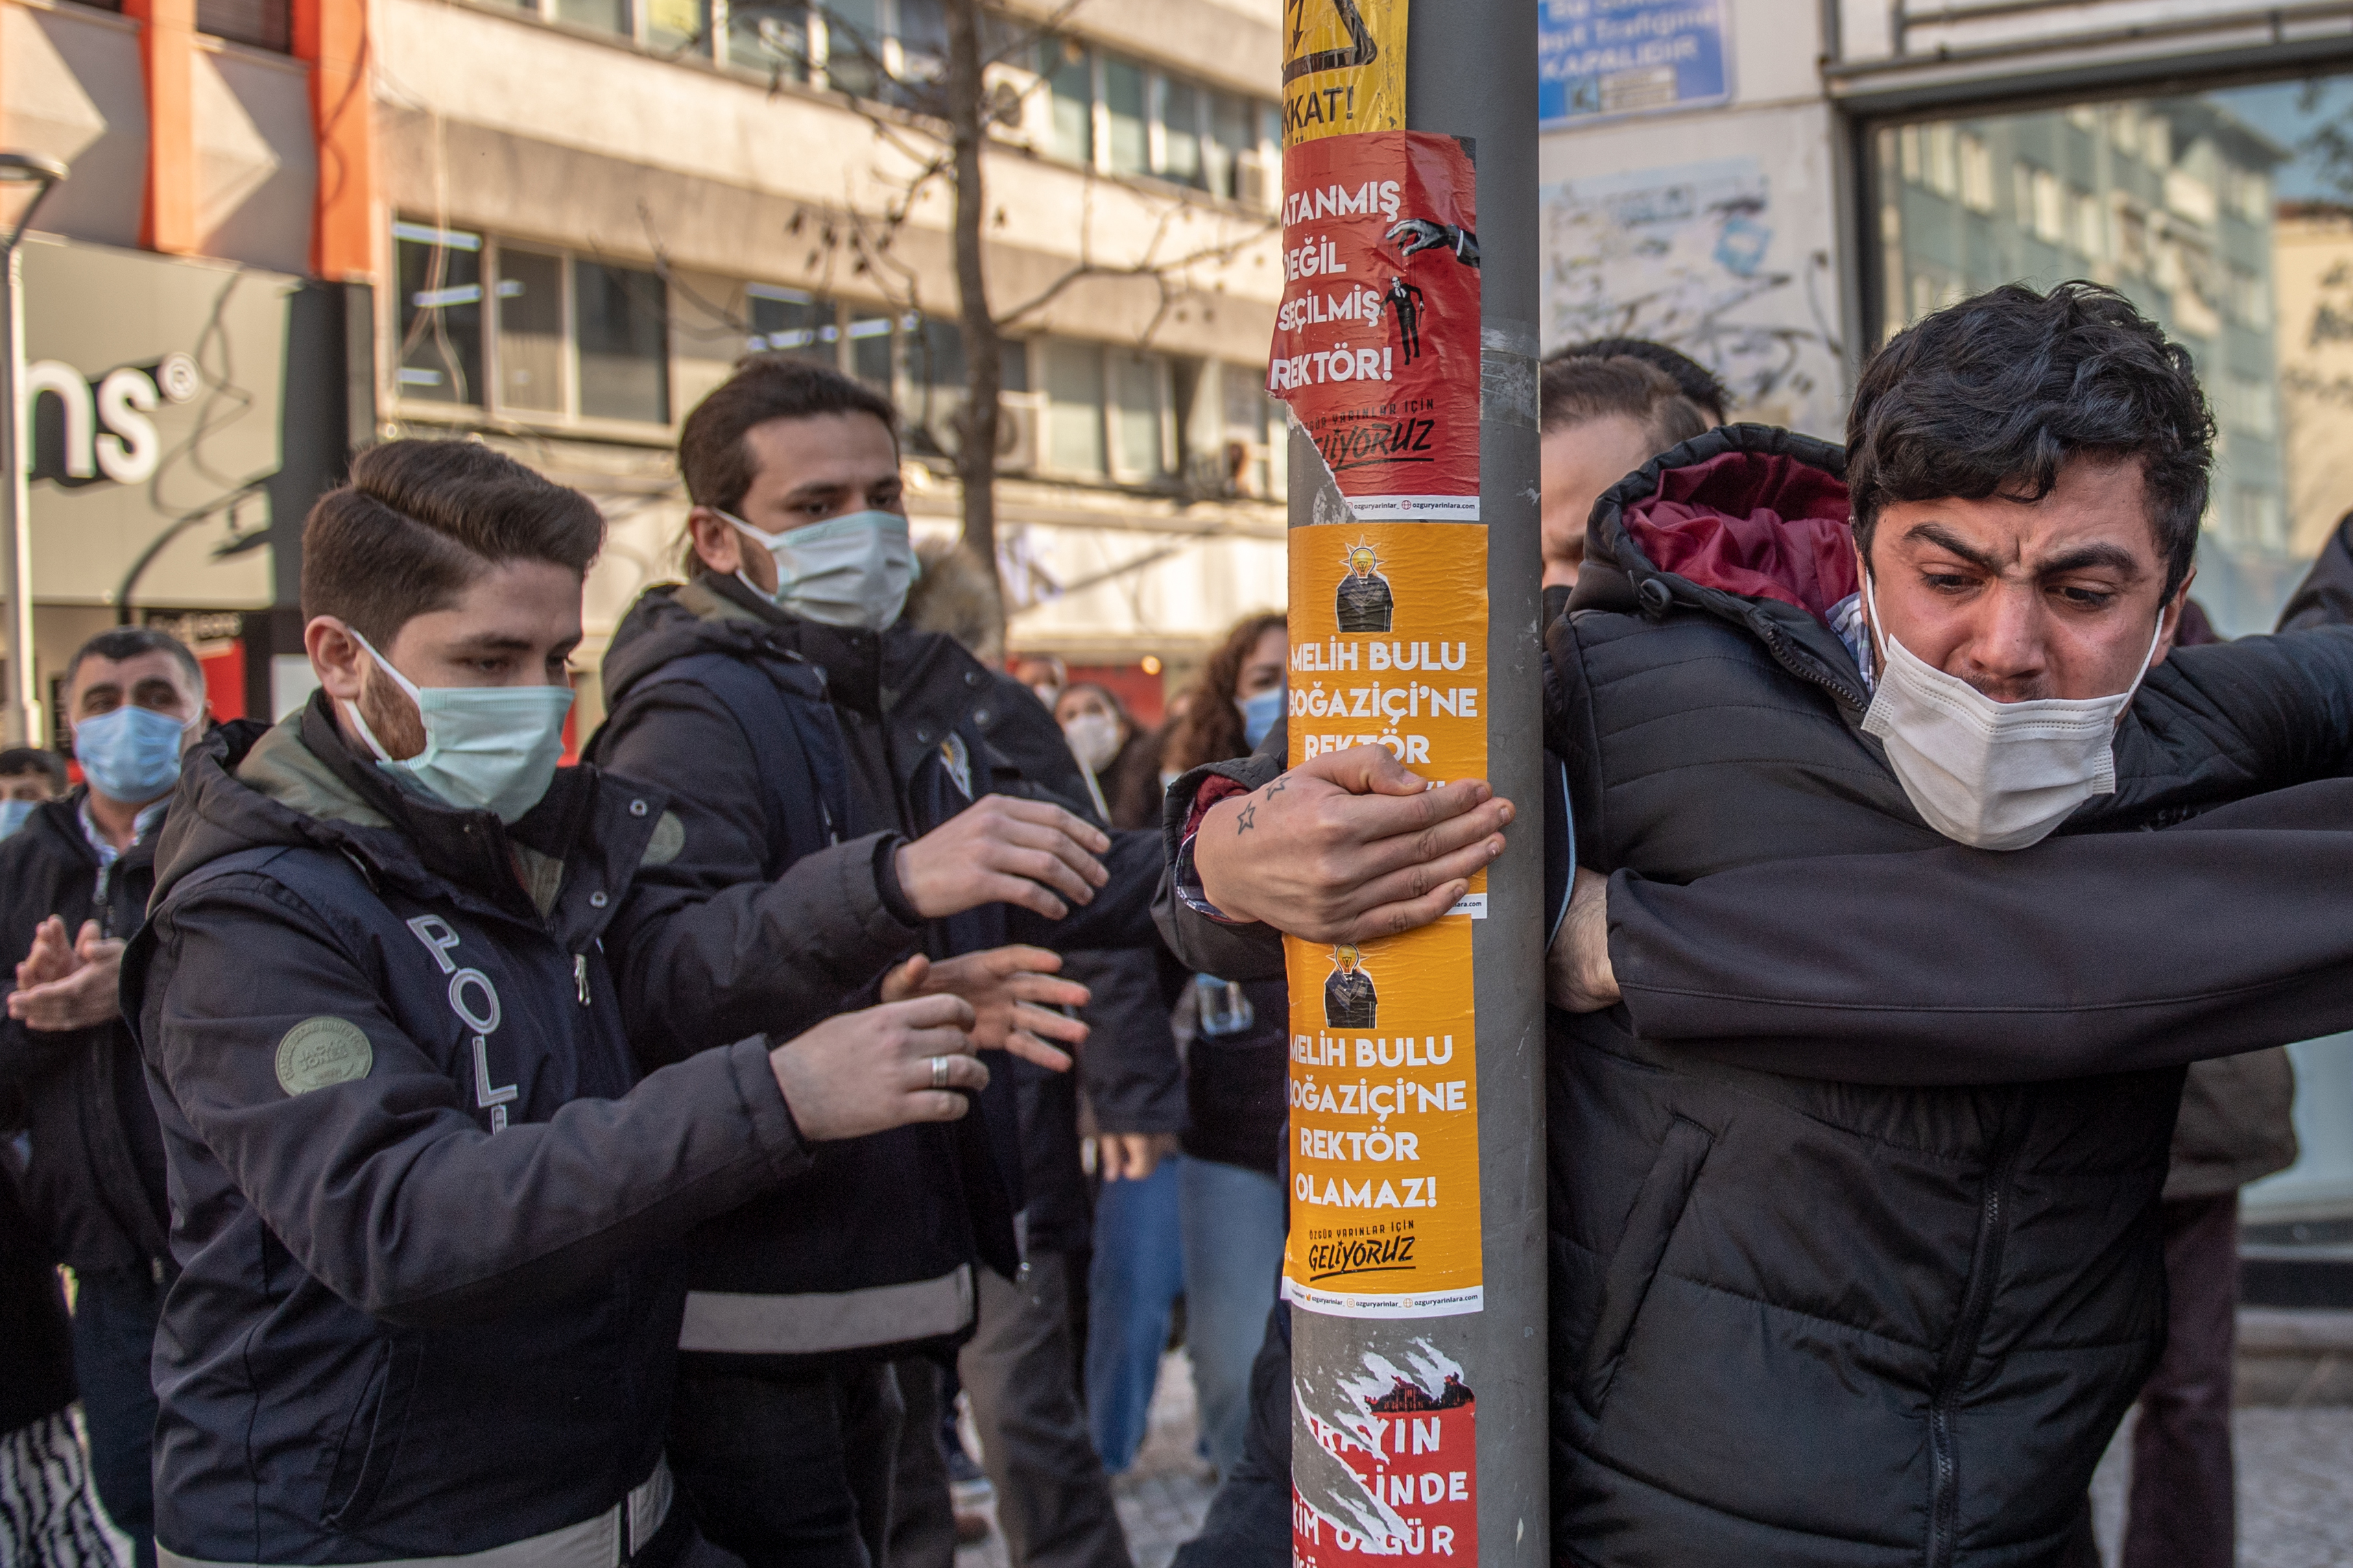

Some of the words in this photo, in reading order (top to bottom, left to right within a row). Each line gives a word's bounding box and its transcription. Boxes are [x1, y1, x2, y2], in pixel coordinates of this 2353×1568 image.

[1282, 180, 1401, 230] ATANMIŞ
[1284, 234, 1346, 284] DEĞİL
[1278, 284, 1381, 335] SEÇİLMİŞ
[1270, 342, 1393, 389] REKTÖR!
[1304, 416, 1326, 432] ZGÜR
[1313, 417, 1435, 468] LİYORUZ
[1413, 502, 1475, 510] ozguryarinlara.com
[1291, 635, 1358, 672] MELİH
[1370, 642, 1466, 671] BULU
[1289, 1030, 1346, 1067] MELİH
[1356, 1035, 1453, 1068] BULU
[1300, 1125, 1420, 1161] REKTÖR
[1295, 1172, 1437, 1208] OLAMAZ!
[1337, 1224, 1385, 1238] YARINLAR
[1309, 1235, 1416, 1273] GELİYORUZ
[1414, 1294, 1479, 1306] ozguryarinlara.com
